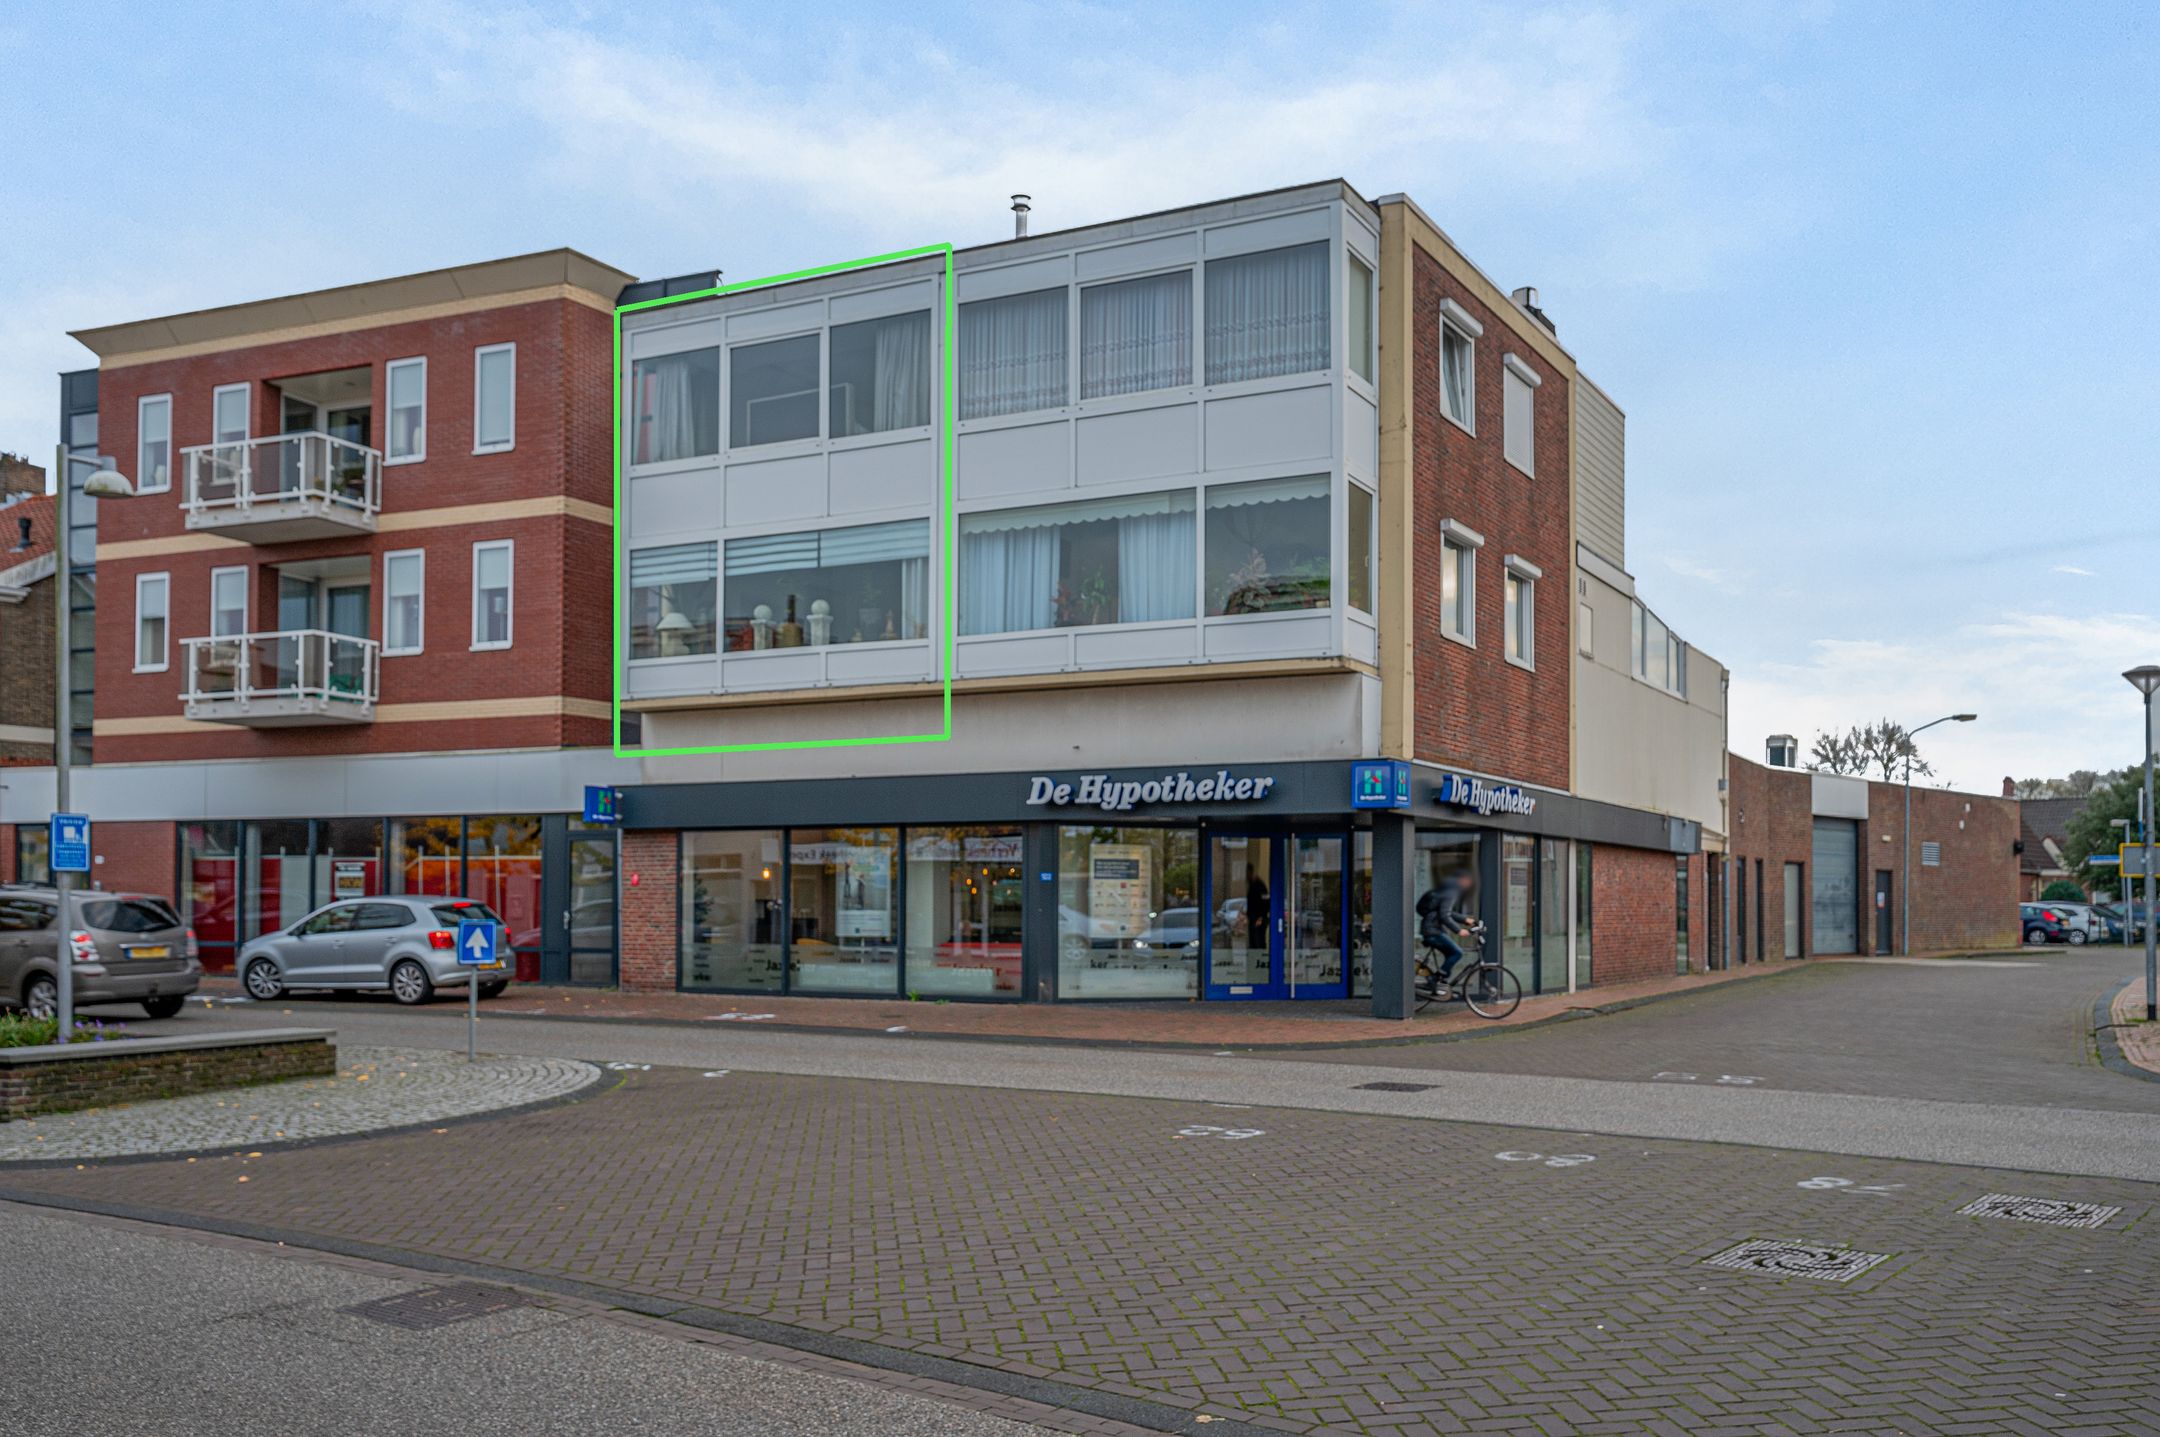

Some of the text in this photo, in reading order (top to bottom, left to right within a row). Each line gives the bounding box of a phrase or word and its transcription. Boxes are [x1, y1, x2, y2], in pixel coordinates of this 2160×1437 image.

[1026, 770, 1274, 810] De Hypotheker
[1449, 774, 1537, 816] De Hypotheker
